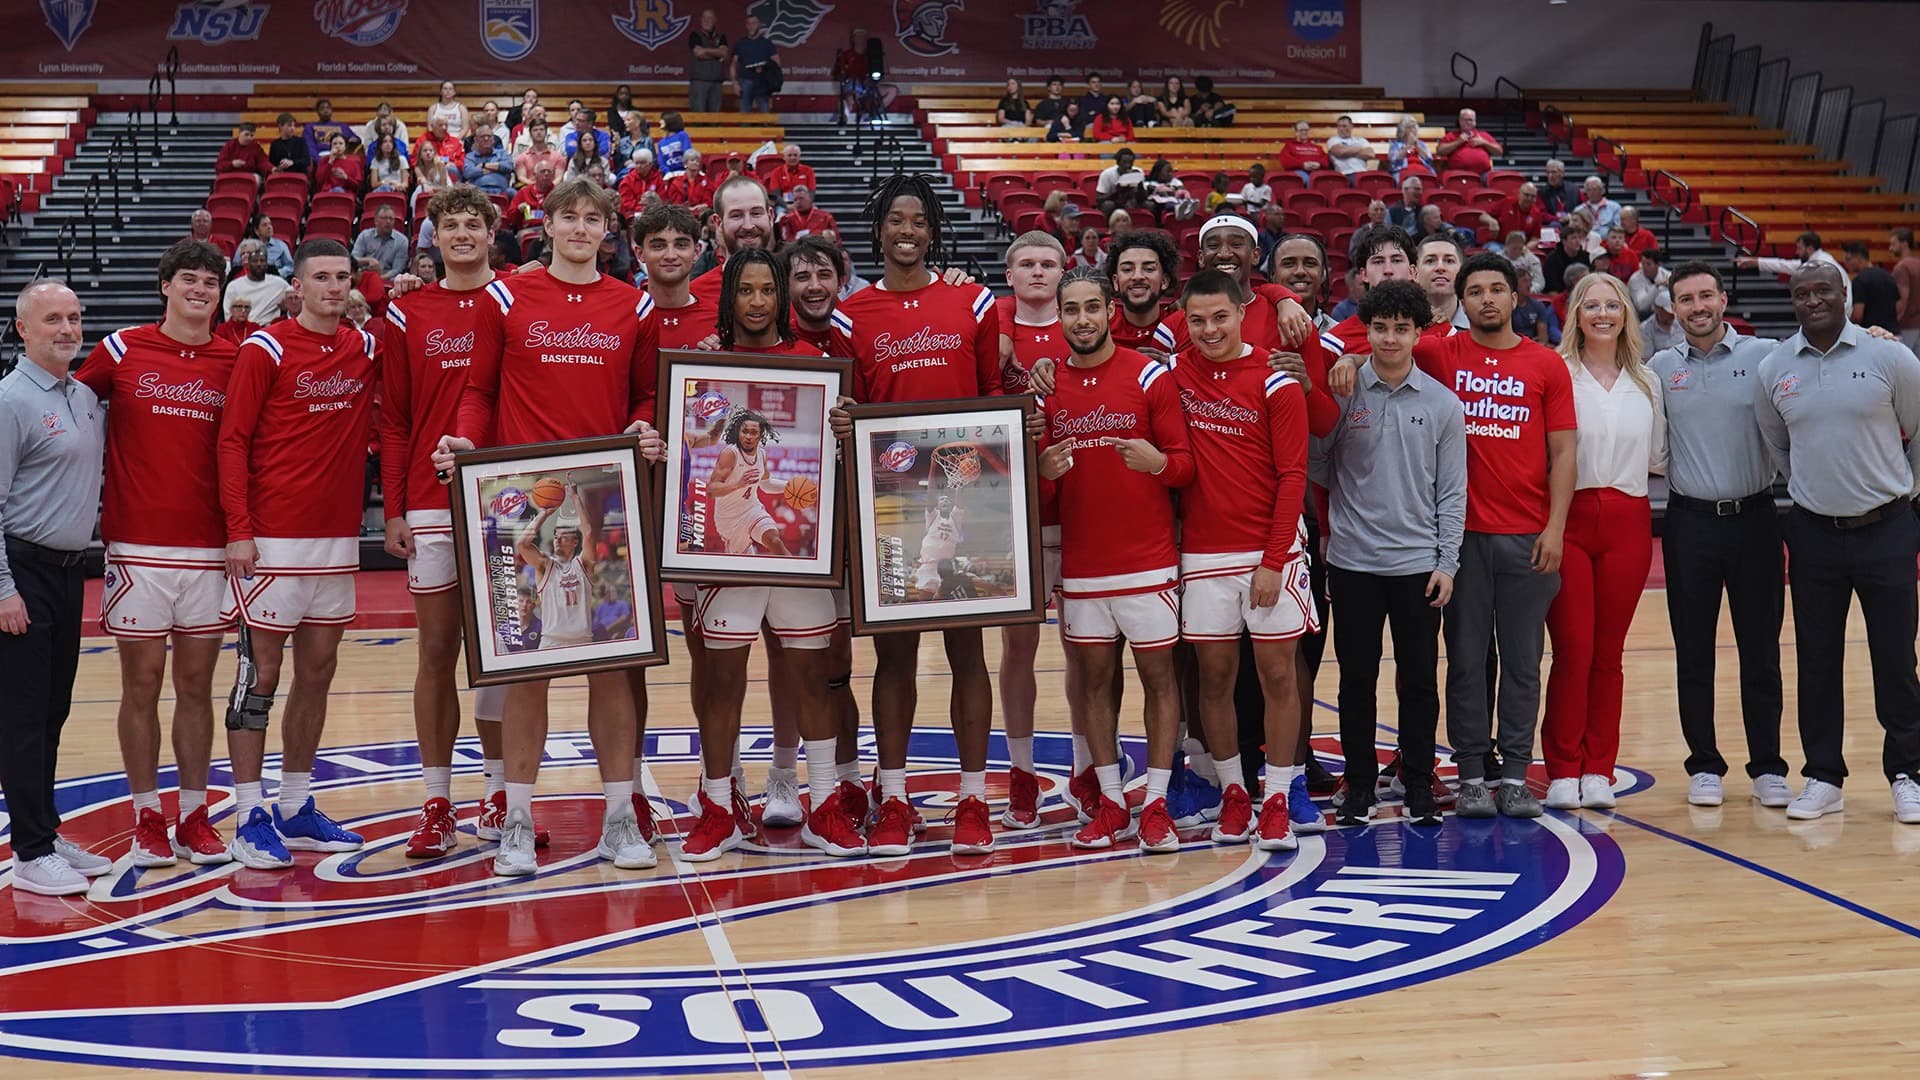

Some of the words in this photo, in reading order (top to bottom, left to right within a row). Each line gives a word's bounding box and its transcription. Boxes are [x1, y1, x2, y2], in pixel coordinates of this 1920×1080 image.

[169, 7, 268, 43] NSU
[1027, 17, 1090, 36] PBA
[1292, 10, 1345, 27] NCAA
[1287, 45, 1335, 59] Division
[39, 63, 60, 74] Lynn
[61, 63, 104, 74] University
[181, 63, 237, 73] Southeastern
[238, 63, 281, 75] University
[317, 63, 346, 72] Florida
[347, 63, 386, 72] Southern
[386, 63, 418, 74] College
[654, 65, 684, 75] College
[525, 320, 621, 351] Southern
[874, 326, 962, 362] Southern
[541, 353, 605, 365] BASKETBALL
[891, 357, 948, 373] BASKETBALL
[293, 370, 364, 399] Southern
[1455, 370, 1525, 397] Florida
[152, 405, 215, 422] BASKETBALL
[308, 402, 353, 413] BASKETBALL
[1180, 388, 1259, 424] Southern
[1460, 396, 1530, 422] uthern
[1052, 405, 1137, 438] Southern
[1465, 421, 1521, 440] sketball
[695, 478, 707, 497] IV
[490, 491, 529, 515] Mocs
[681, 513, 694, 544] JOE
[693, 500, 706, 547] MOON
[879, 534, 893, 597] PEYTON
[891, 536, 905, 597] GERALD
[501, 545, 523, 646] FEIERBERGS
[495, 865, 1521, 1048] SOUTHERN
